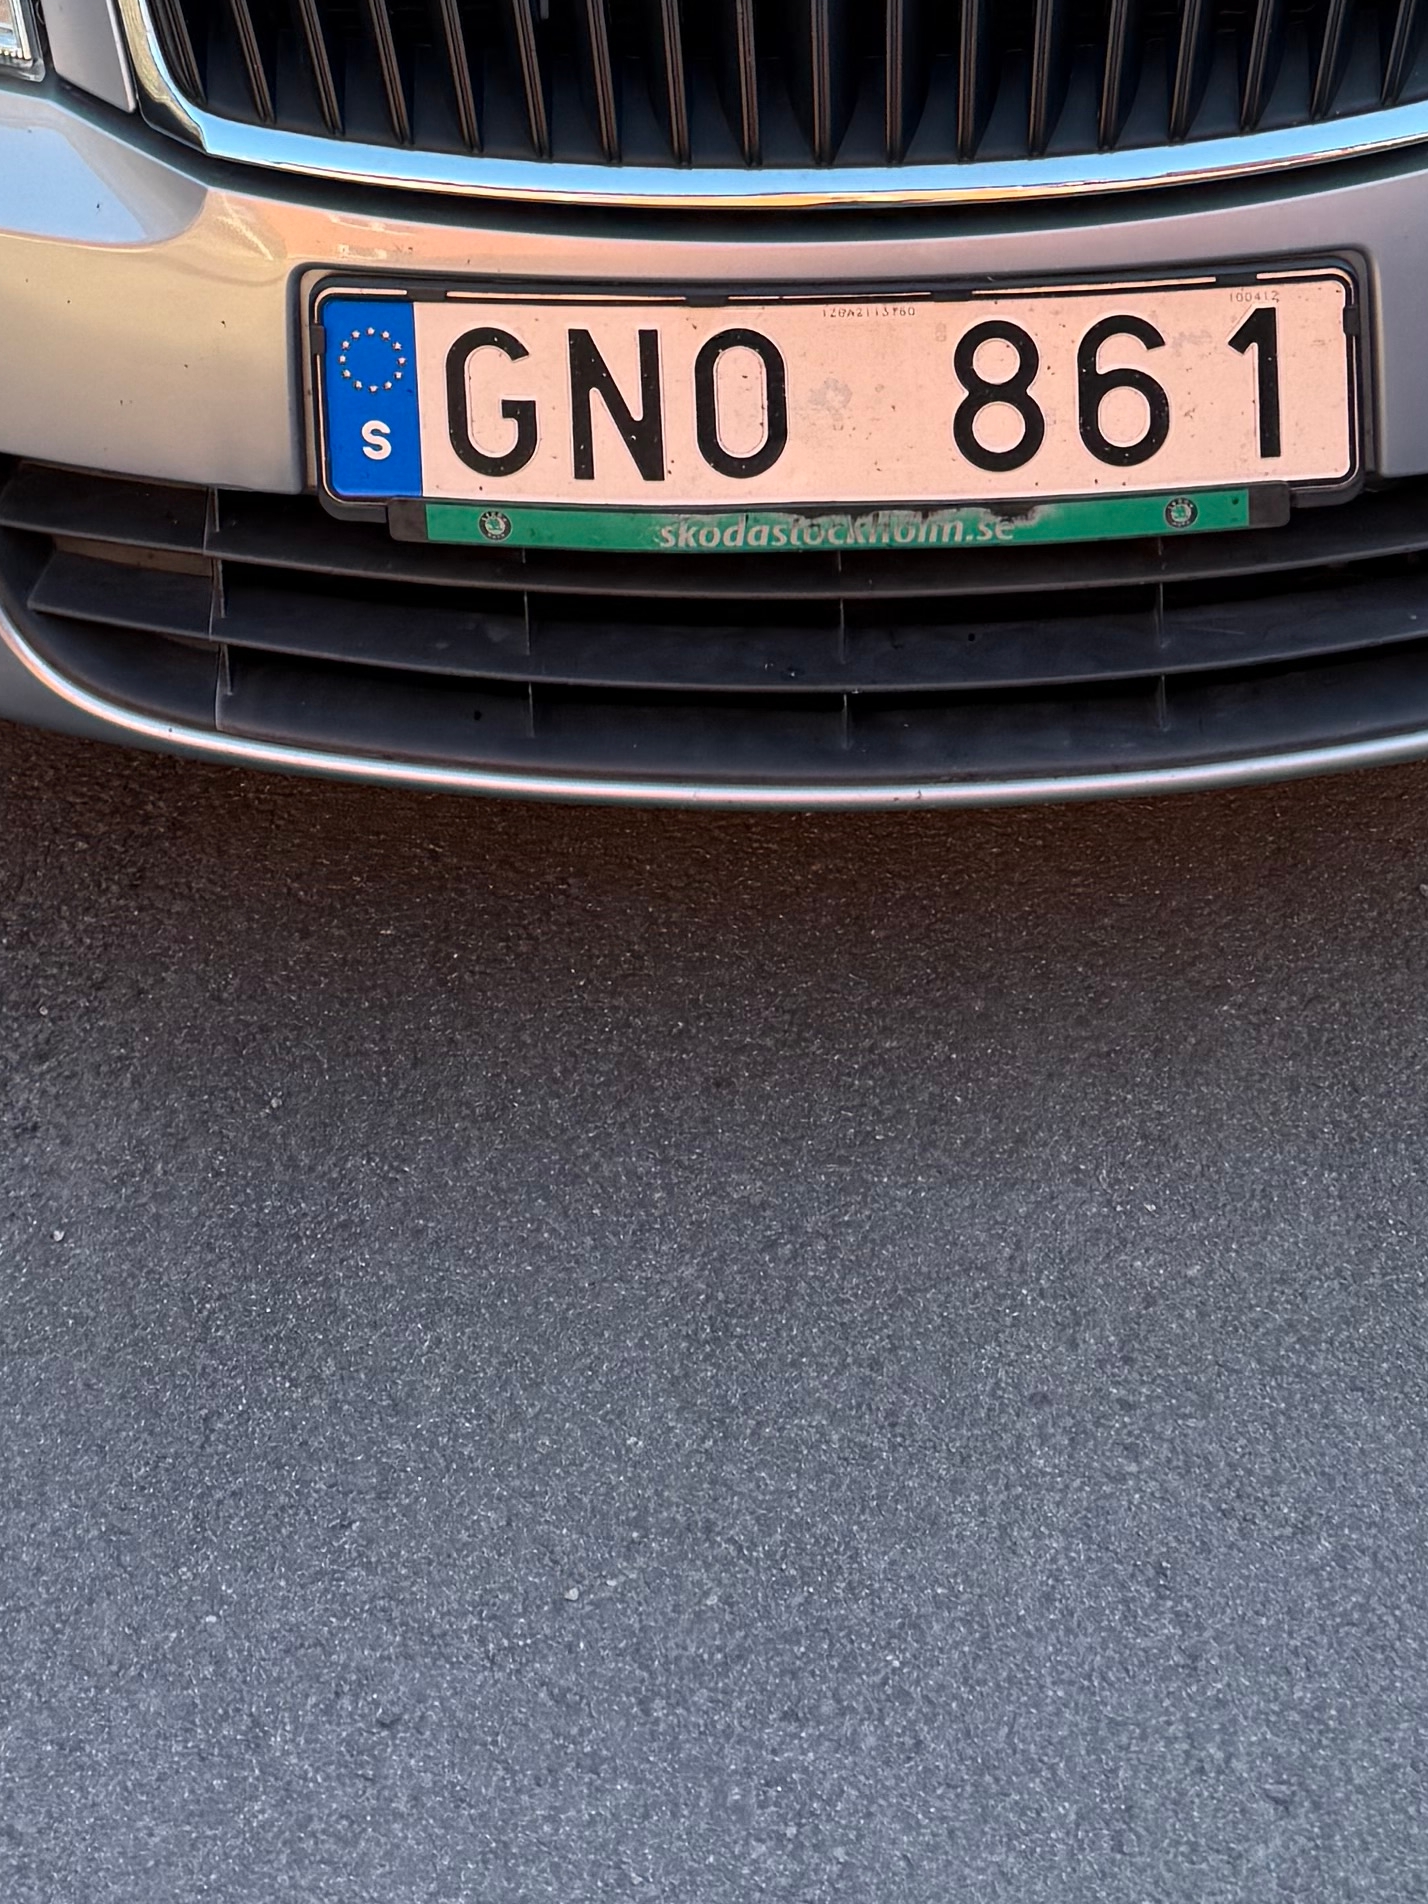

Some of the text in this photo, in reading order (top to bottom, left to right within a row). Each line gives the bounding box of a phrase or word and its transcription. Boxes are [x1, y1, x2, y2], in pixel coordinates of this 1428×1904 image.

[361, 419, 392, 461] S
[446, 307, 1280, 481] GNO 861
